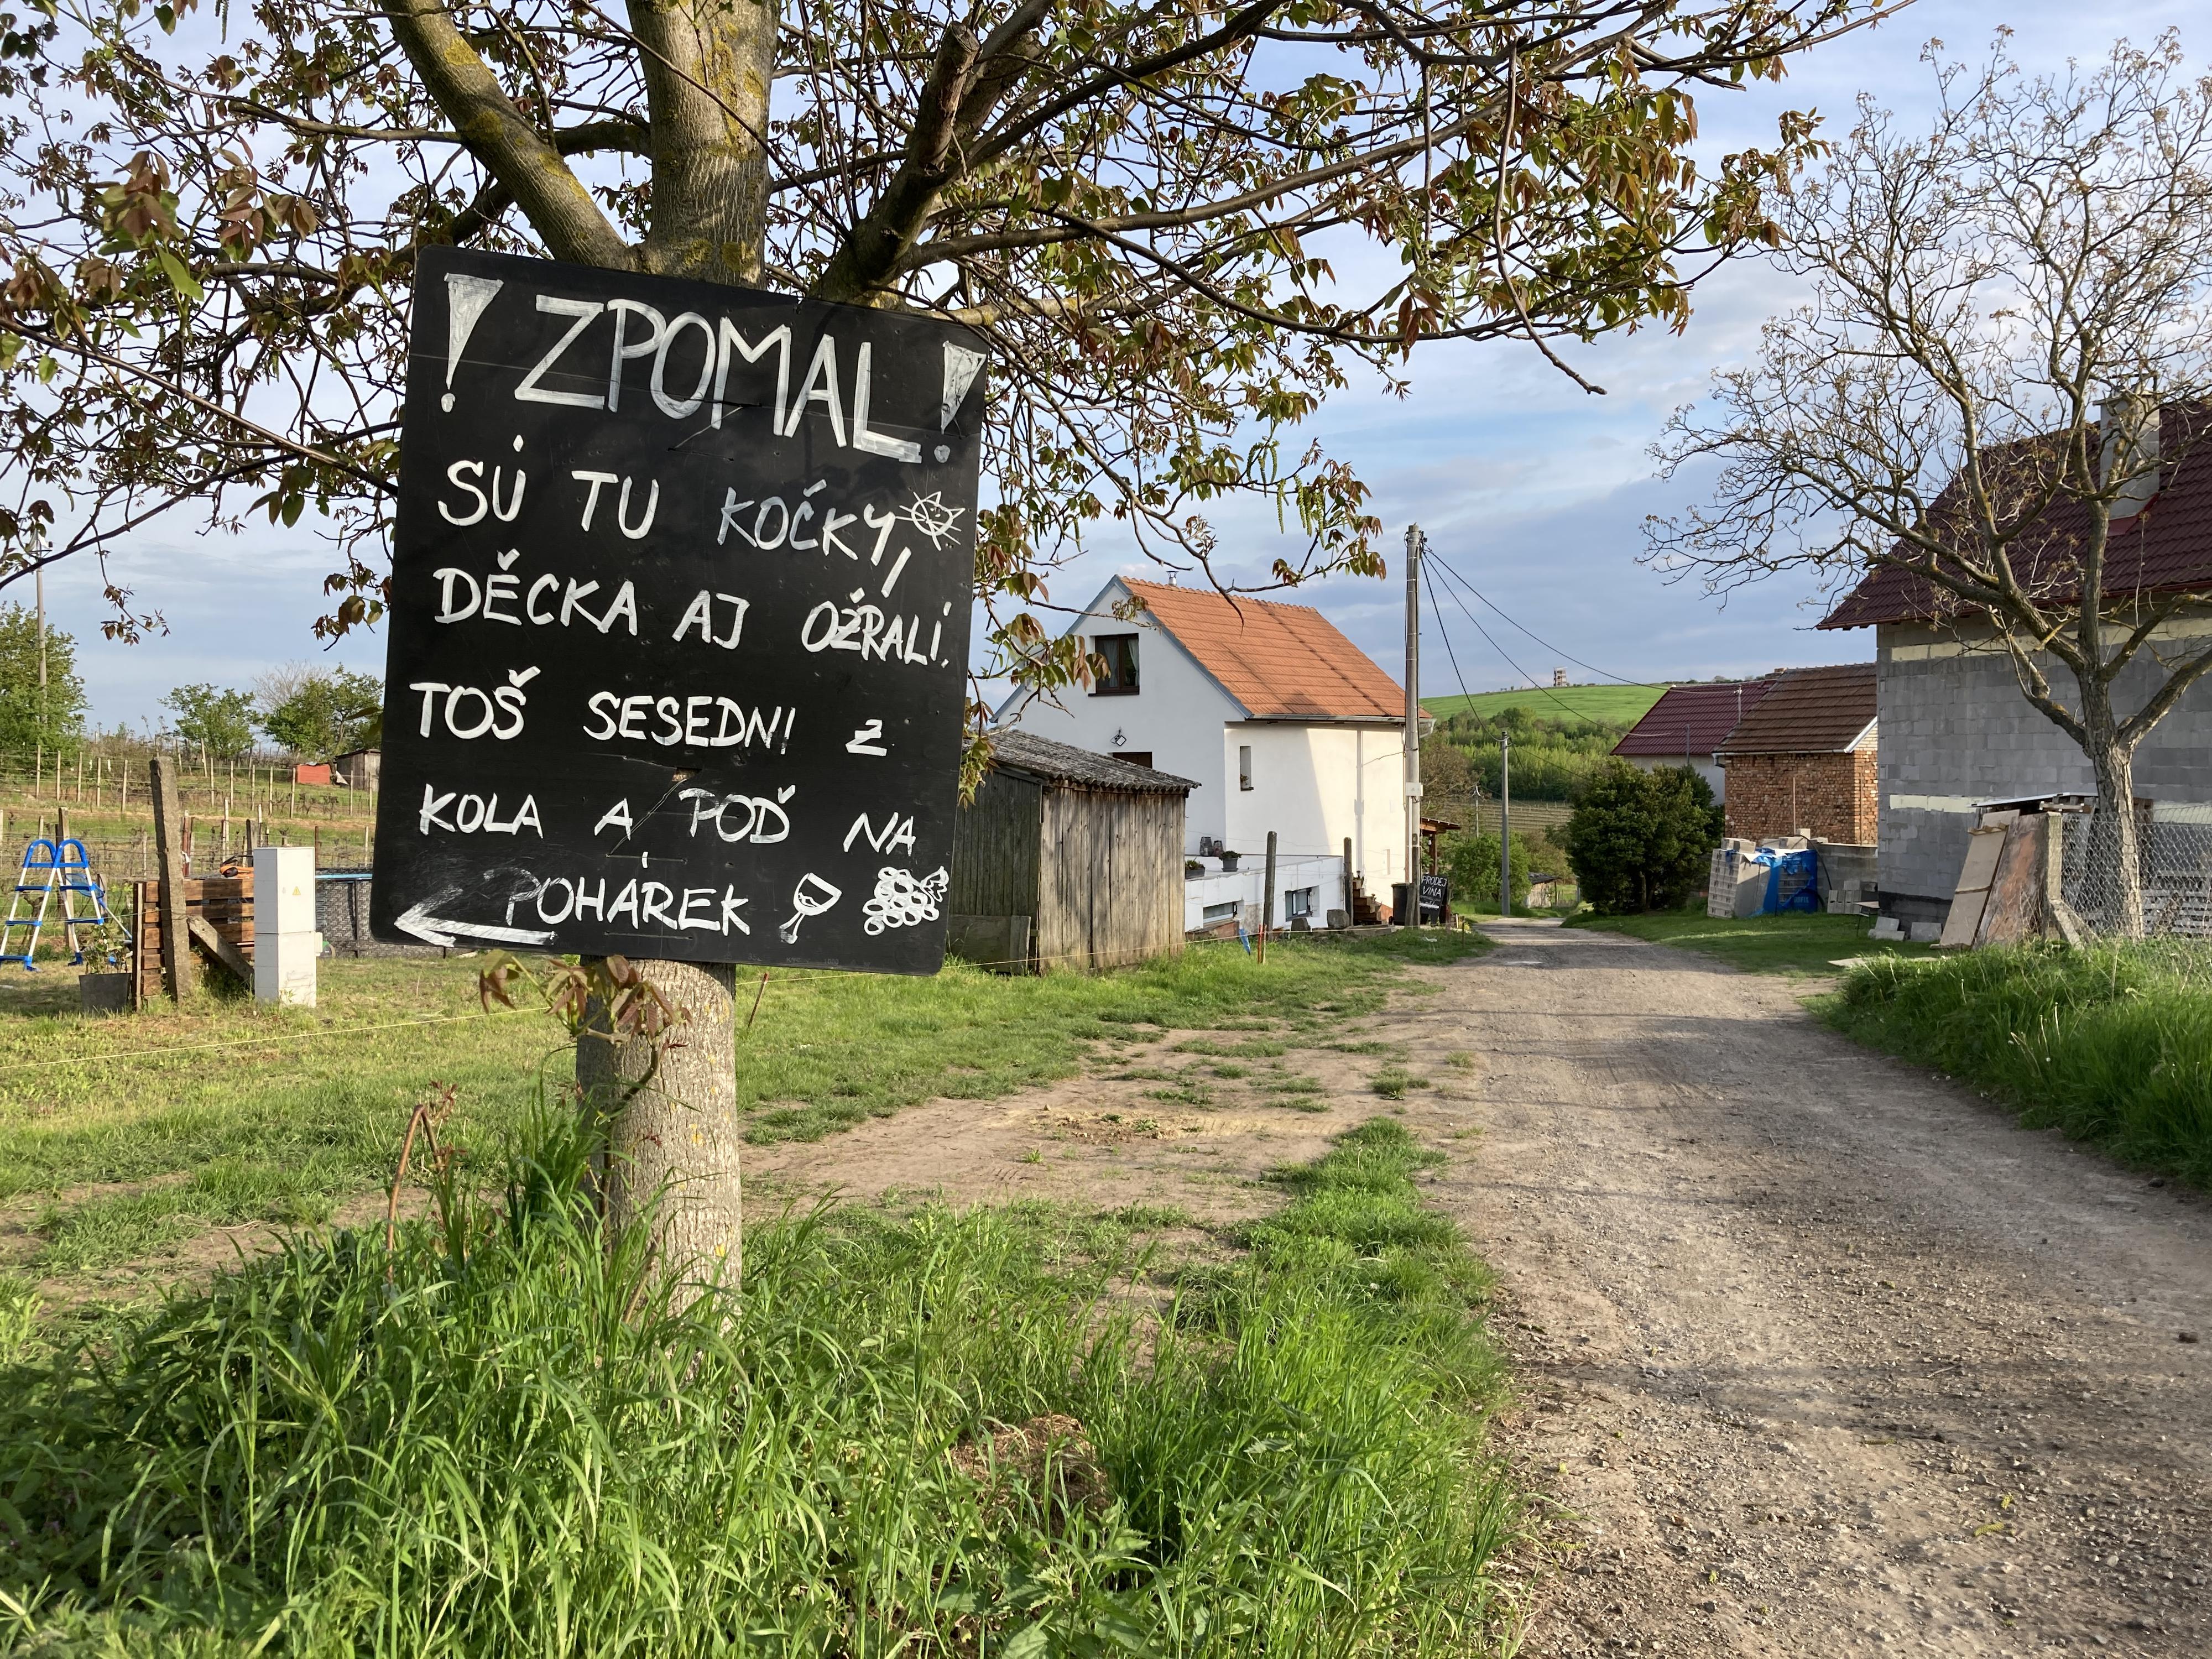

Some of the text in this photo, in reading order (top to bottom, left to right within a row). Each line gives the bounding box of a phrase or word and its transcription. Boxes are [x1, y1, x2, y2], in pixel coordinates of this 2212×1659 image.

[441, 273, 504, 414] !
[514, 294, 922, 463] ZPOMAL
[437, 434, 527, 526] SÚ
[571, 469, 660, 540] TU
[432, 548, 638, 636] DĚCKA
[671, 589, 750, 650] AJ
[409, 665, 888, 757] TOŠ SESEDNI Z
[419, 783, 916, 857] KOLA A POĎ NA
[483, 851, 750, 936] POHÁREK
[1421, 875, 1447, 887] PRODEJ
